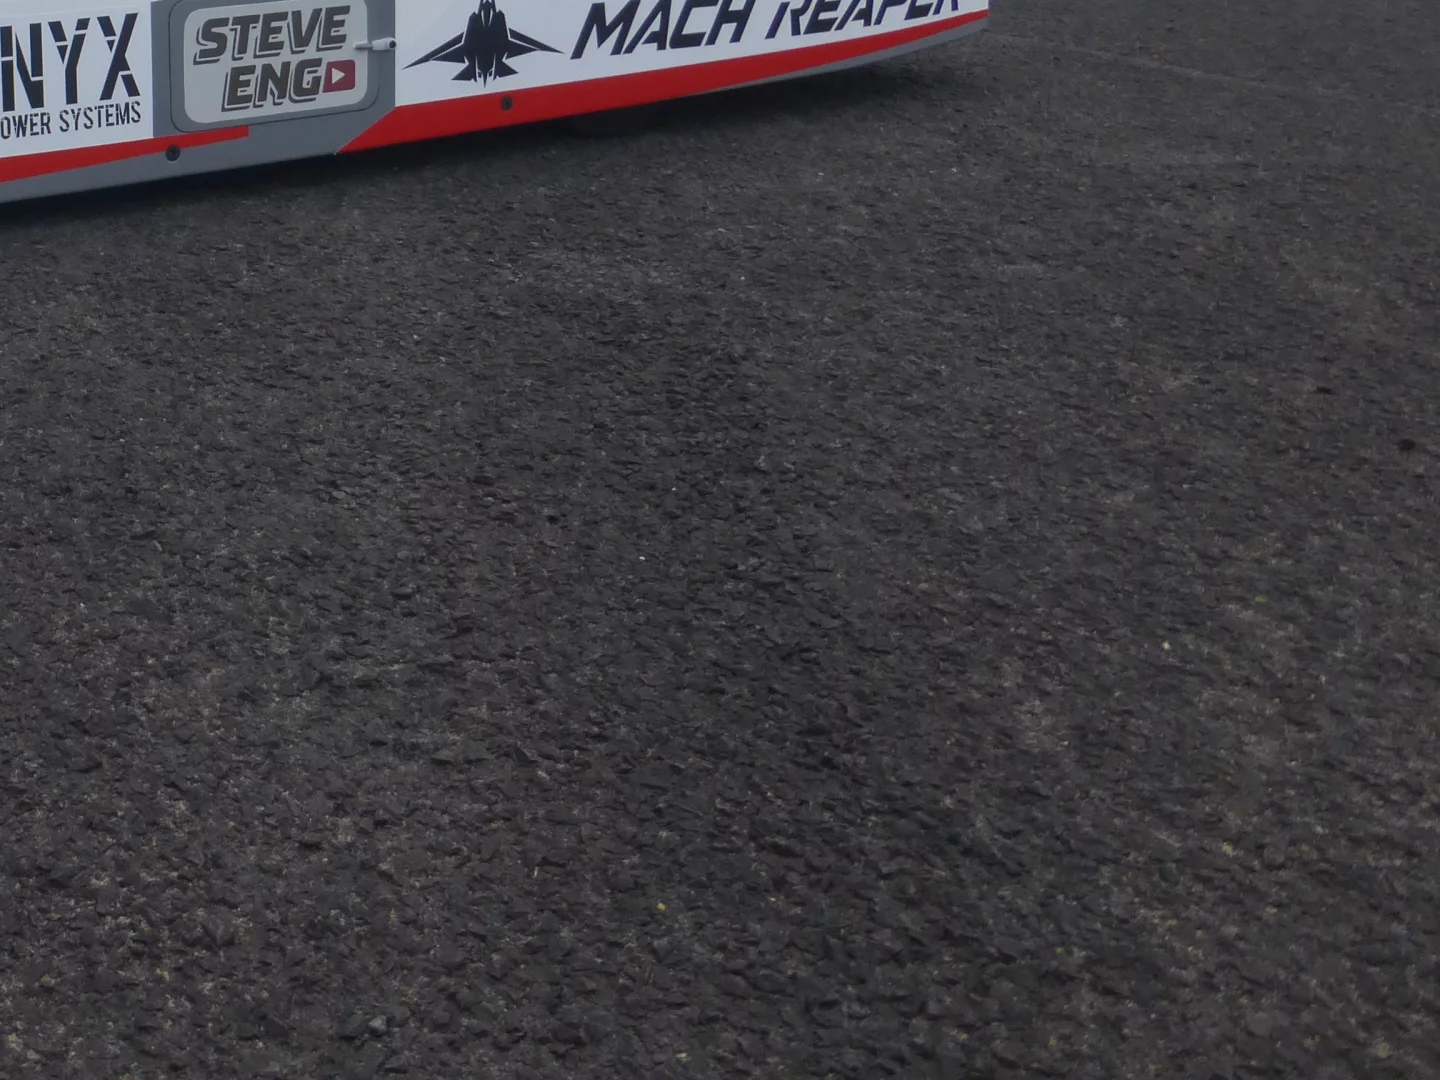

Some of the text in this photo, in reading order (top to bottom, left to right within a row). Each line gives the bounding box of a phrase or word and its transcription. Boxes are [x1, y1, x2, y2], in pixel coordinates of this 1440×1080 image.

[193, 5, 351, 65] STEVE
[221, 58, 323, 113] ENG
[59, 101, 142, 132] SYSTEMS
